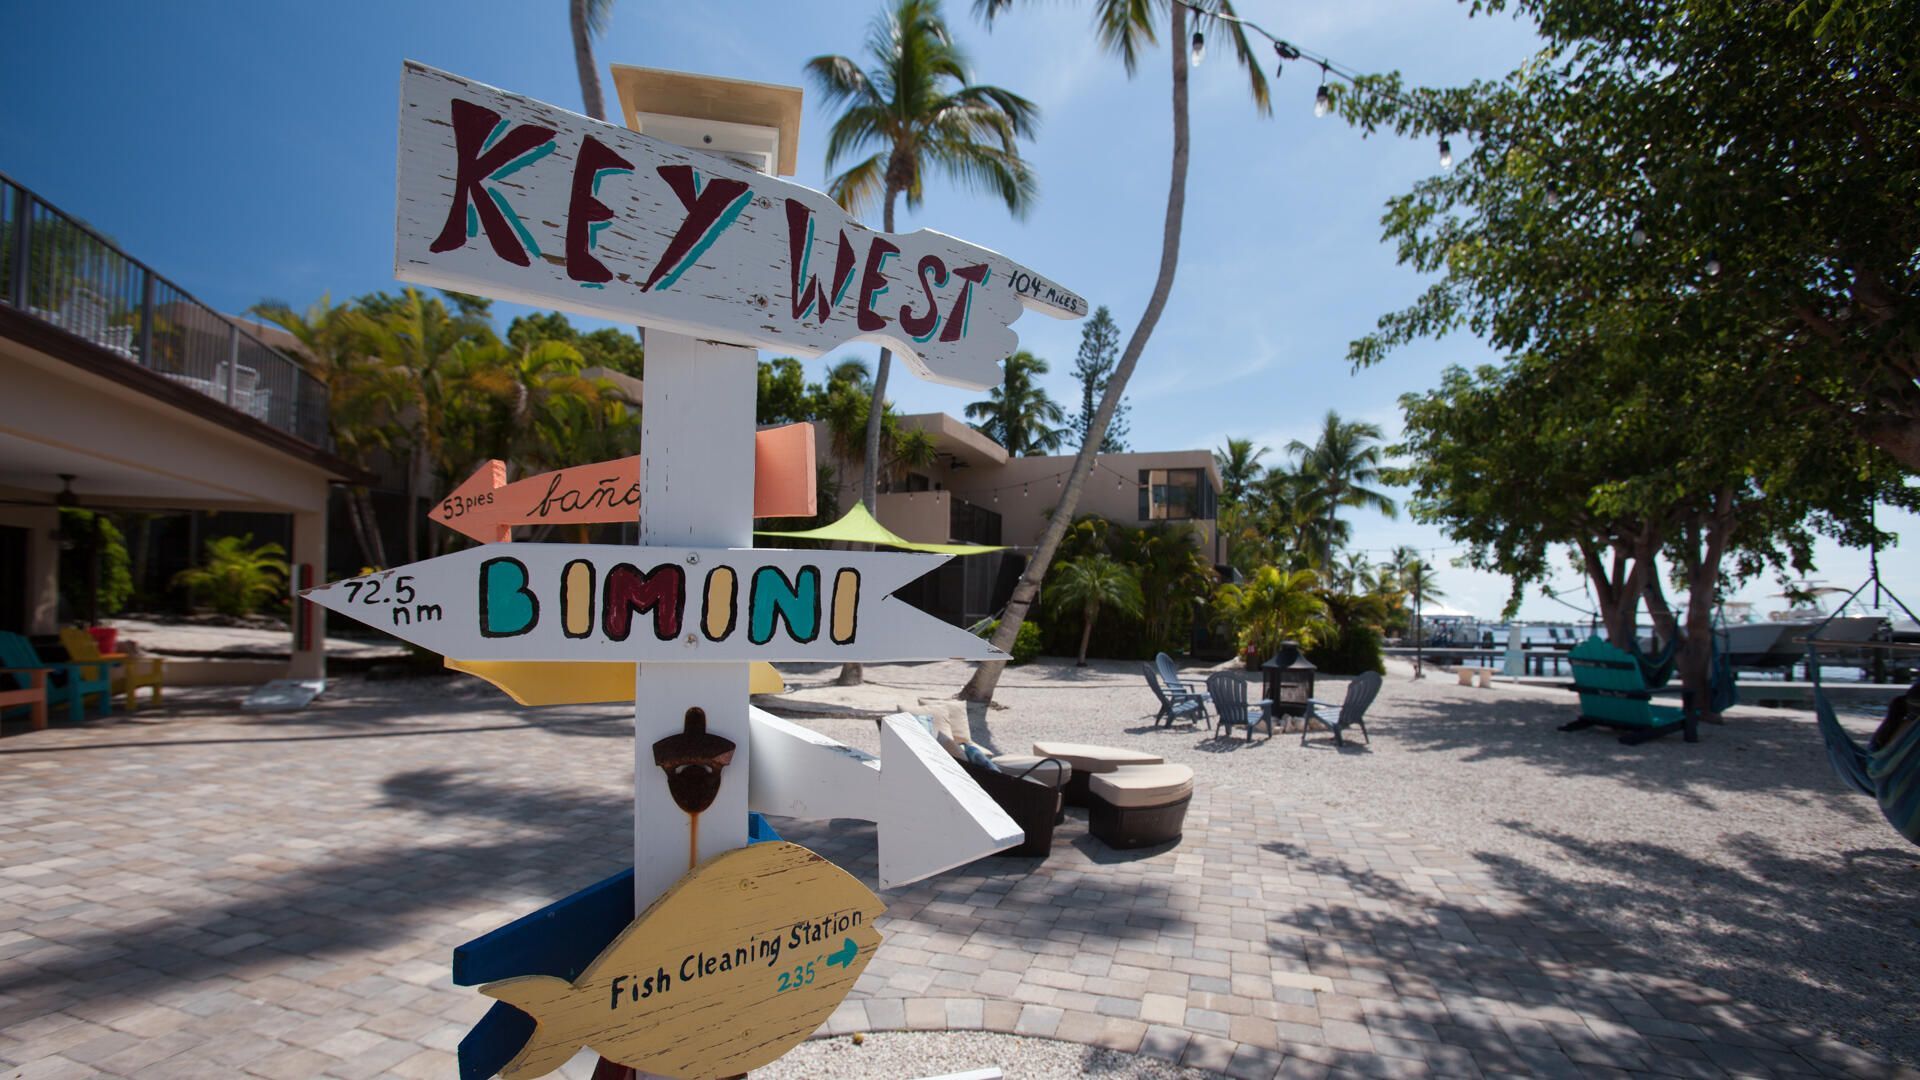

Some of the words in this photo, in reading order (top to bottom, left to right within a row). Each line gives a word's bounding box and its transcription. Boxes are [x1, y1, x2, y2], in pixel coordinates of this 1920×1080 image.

[430, 98, 753, 293] KEY
[786, 199, 990, 343] WEST
[1008, 270, 1041, 297] 104
[443, 496, 465, 519] 53
[466, 491, 494, 512] pies
[344, 576, 415, 604] 72.5
[479, 556, 860, 645] BIMINI
[393, 604, 442, 626] nm
[611, 967, 671, 1009] Fish
[679, 935, 782, 982] Cleaning
[788, 910, 862, 949] Station
